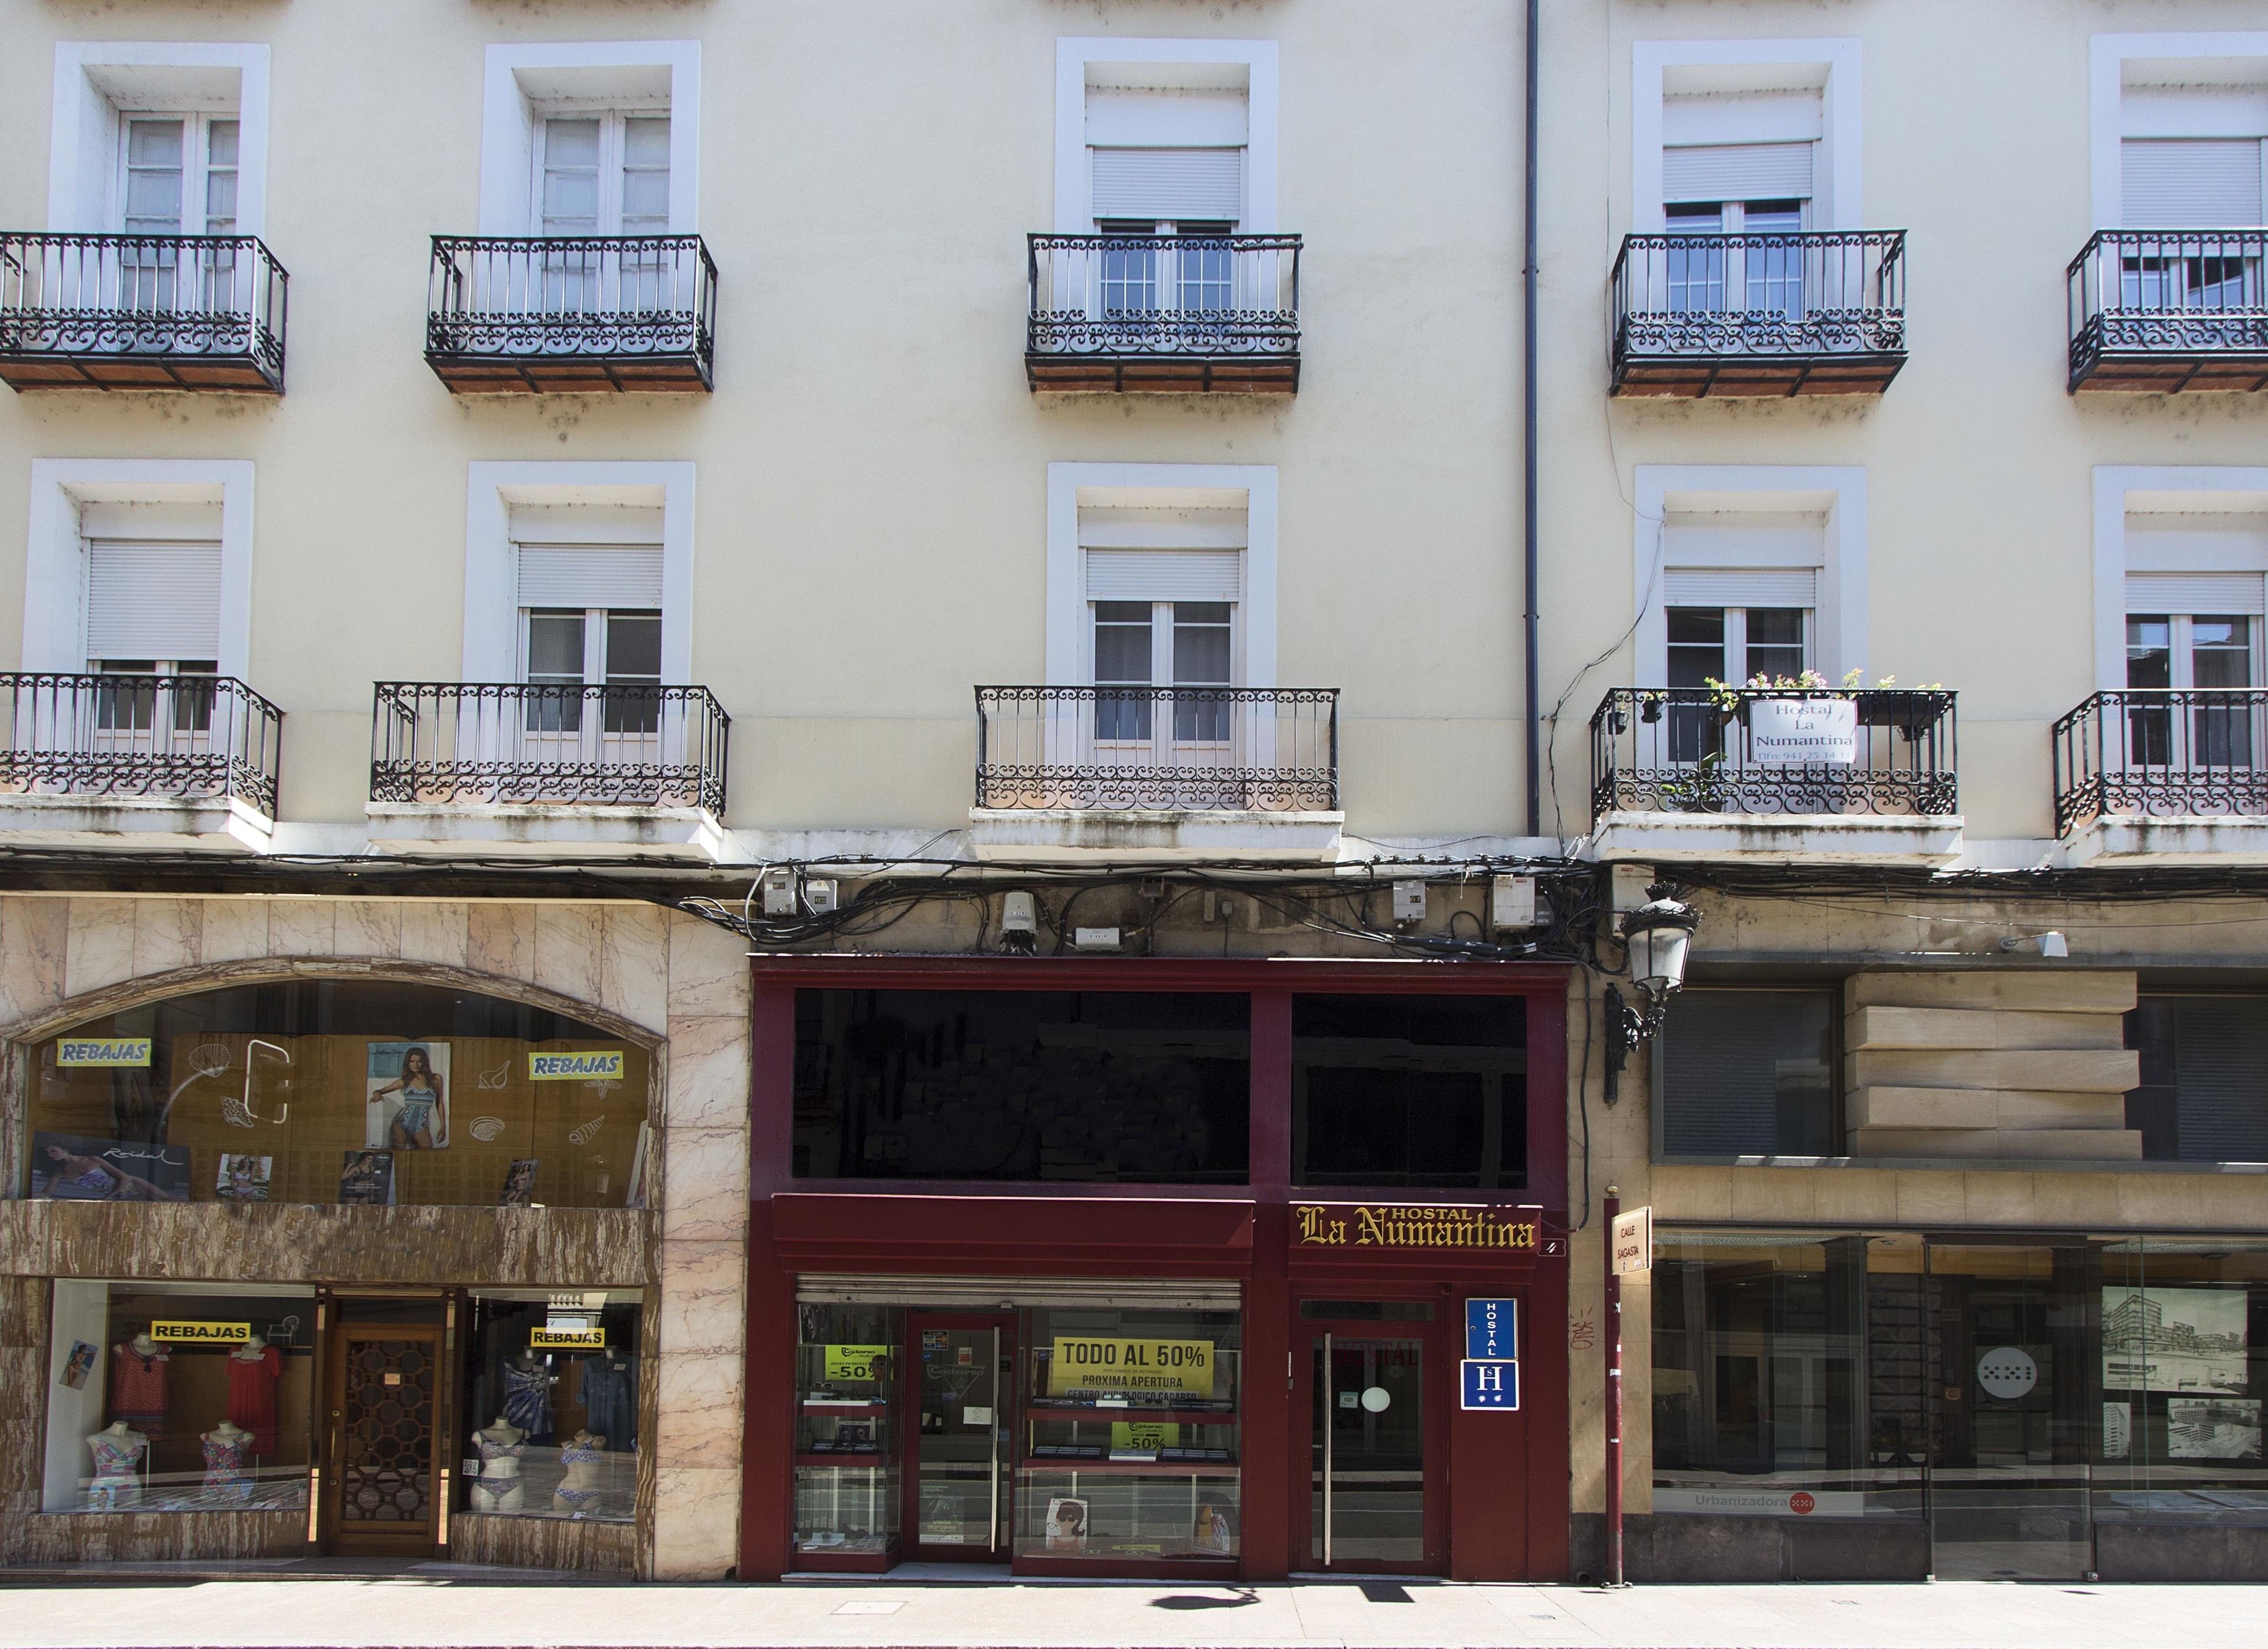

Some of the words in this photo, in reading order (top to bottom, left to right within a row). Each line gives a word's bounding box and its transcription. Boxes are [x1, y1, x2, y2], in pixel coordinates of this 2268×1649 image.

[1775, 704, 1833, 715] Hostal
[1795, 720, 1814, 730] La
[1757, 735, 1852, 747] Numantina
[62, 1043, 148, 1061] REBAJAS
[534, 1055, 620, 1074] REBAJAS
[1391, 1208, 1472, 1220] HOSTAL
[1296, 1206, 1347, 1245] La
[1353, 1207, 1536, 1247] Numantina
[1621, 1225, 1635, 1238] CALLE
[1546, 1242, 1556, 1253] 4
[1617, 1246, 1639, 1259] SAGASTA
[155, 1325, 247, 1338] REBAJAS
[1486, 1303, 1497, 1355] HOSTAL
[534, 1331, 602, 1344] REBAJAS
[1063, 1342, 1116, 1364] TODO
[1123, 1344, 1149, 1366] AL
[1156, 1345, 1205, 1367] 50%
[1082, 1375, 1128, 1386] PROXIMA
[1130, 1376, 1183, 1388] APERTURA
[1067, 1390, 1100, 1399] CENTRO
[1125, 1438, 1166, 1449] -50%
[1695, 1494, 1788, 1507] Urbanizadora
